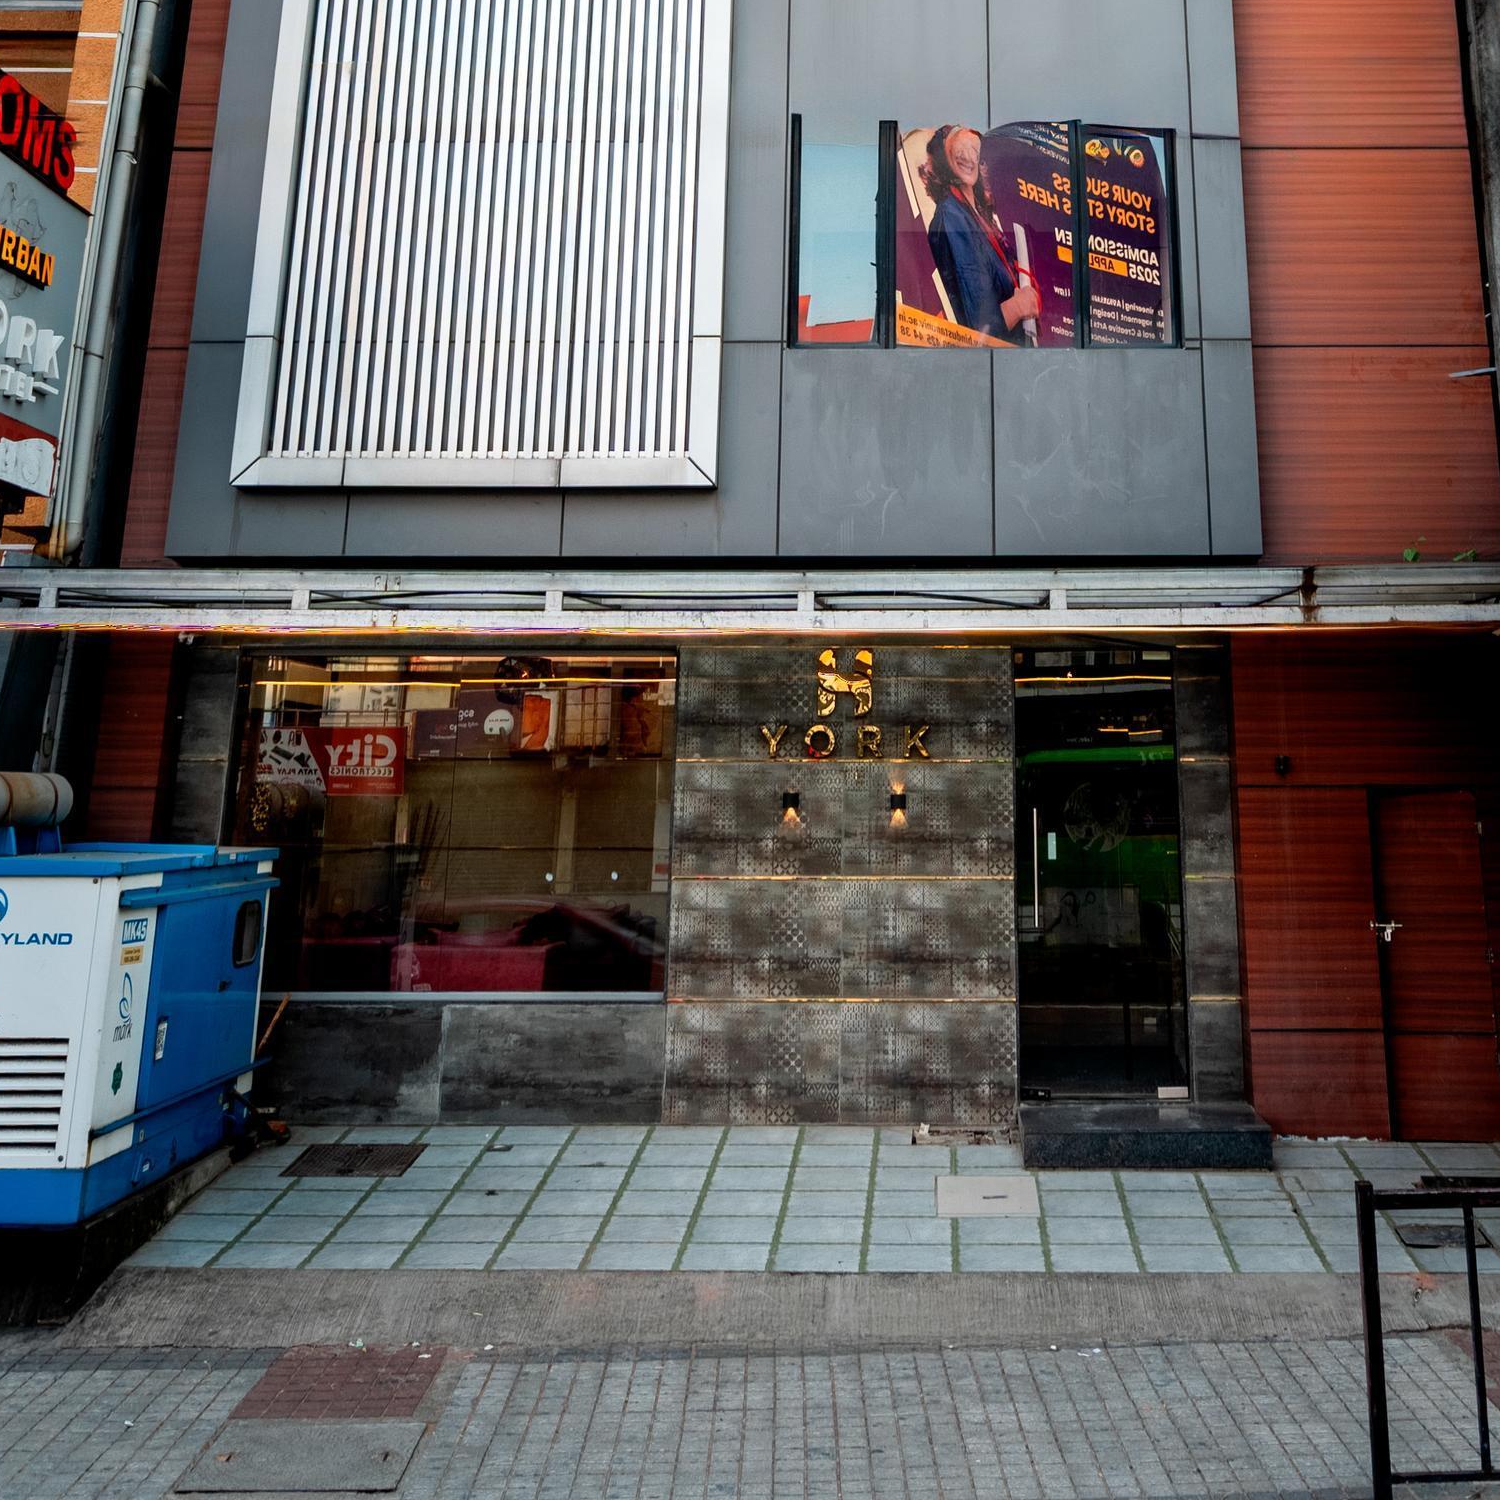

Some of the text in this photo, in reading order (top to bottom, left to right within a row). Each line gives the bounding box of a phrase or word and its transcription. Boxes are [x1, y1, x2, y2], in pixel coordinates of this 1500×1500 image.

[758, 722, 931, 759] YORK
[122, 920, 148, 942] MK45
[112, 1022, 133, 1043] mark
